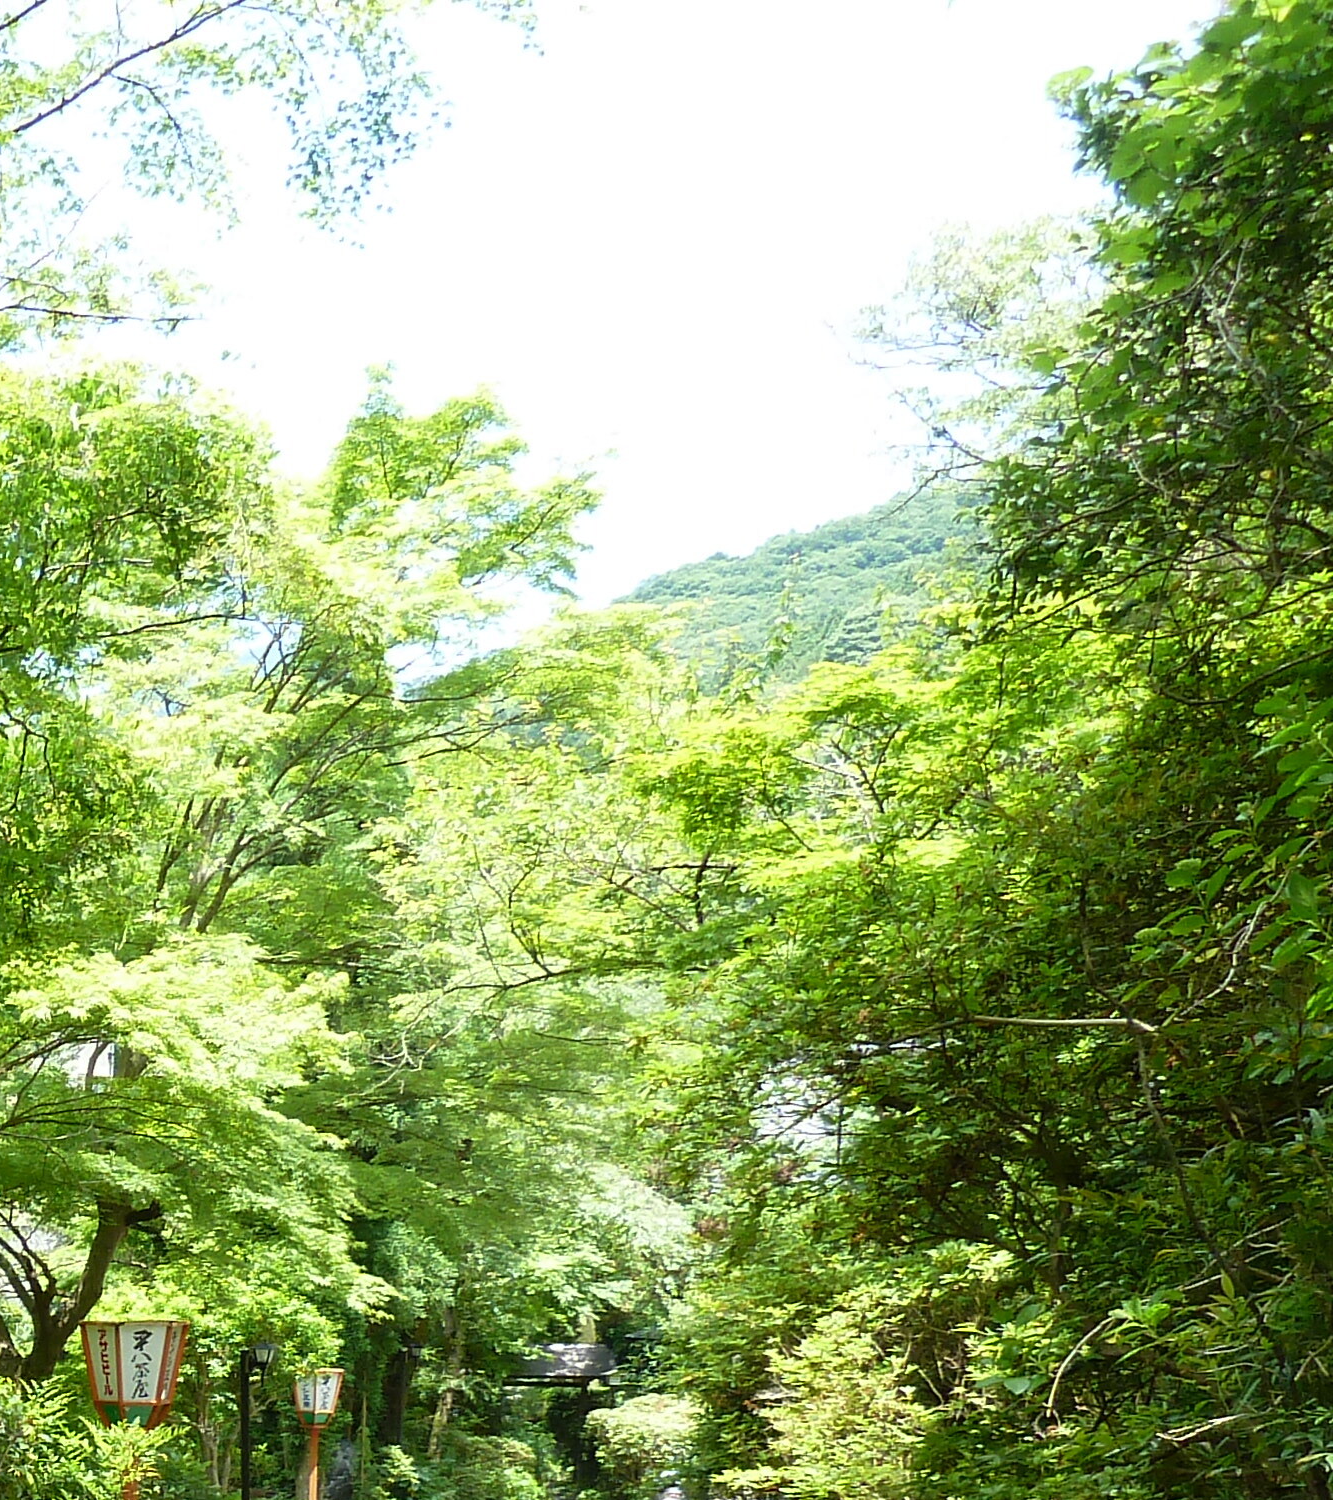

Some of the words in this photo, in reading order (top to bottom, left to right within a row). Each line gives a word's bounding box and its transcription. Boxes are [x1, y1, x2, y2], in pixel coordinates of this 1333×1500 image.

[98, 1329, 114, 1396] アサヒビール
[131, 1329, 153, 1399] 平八茶屋
